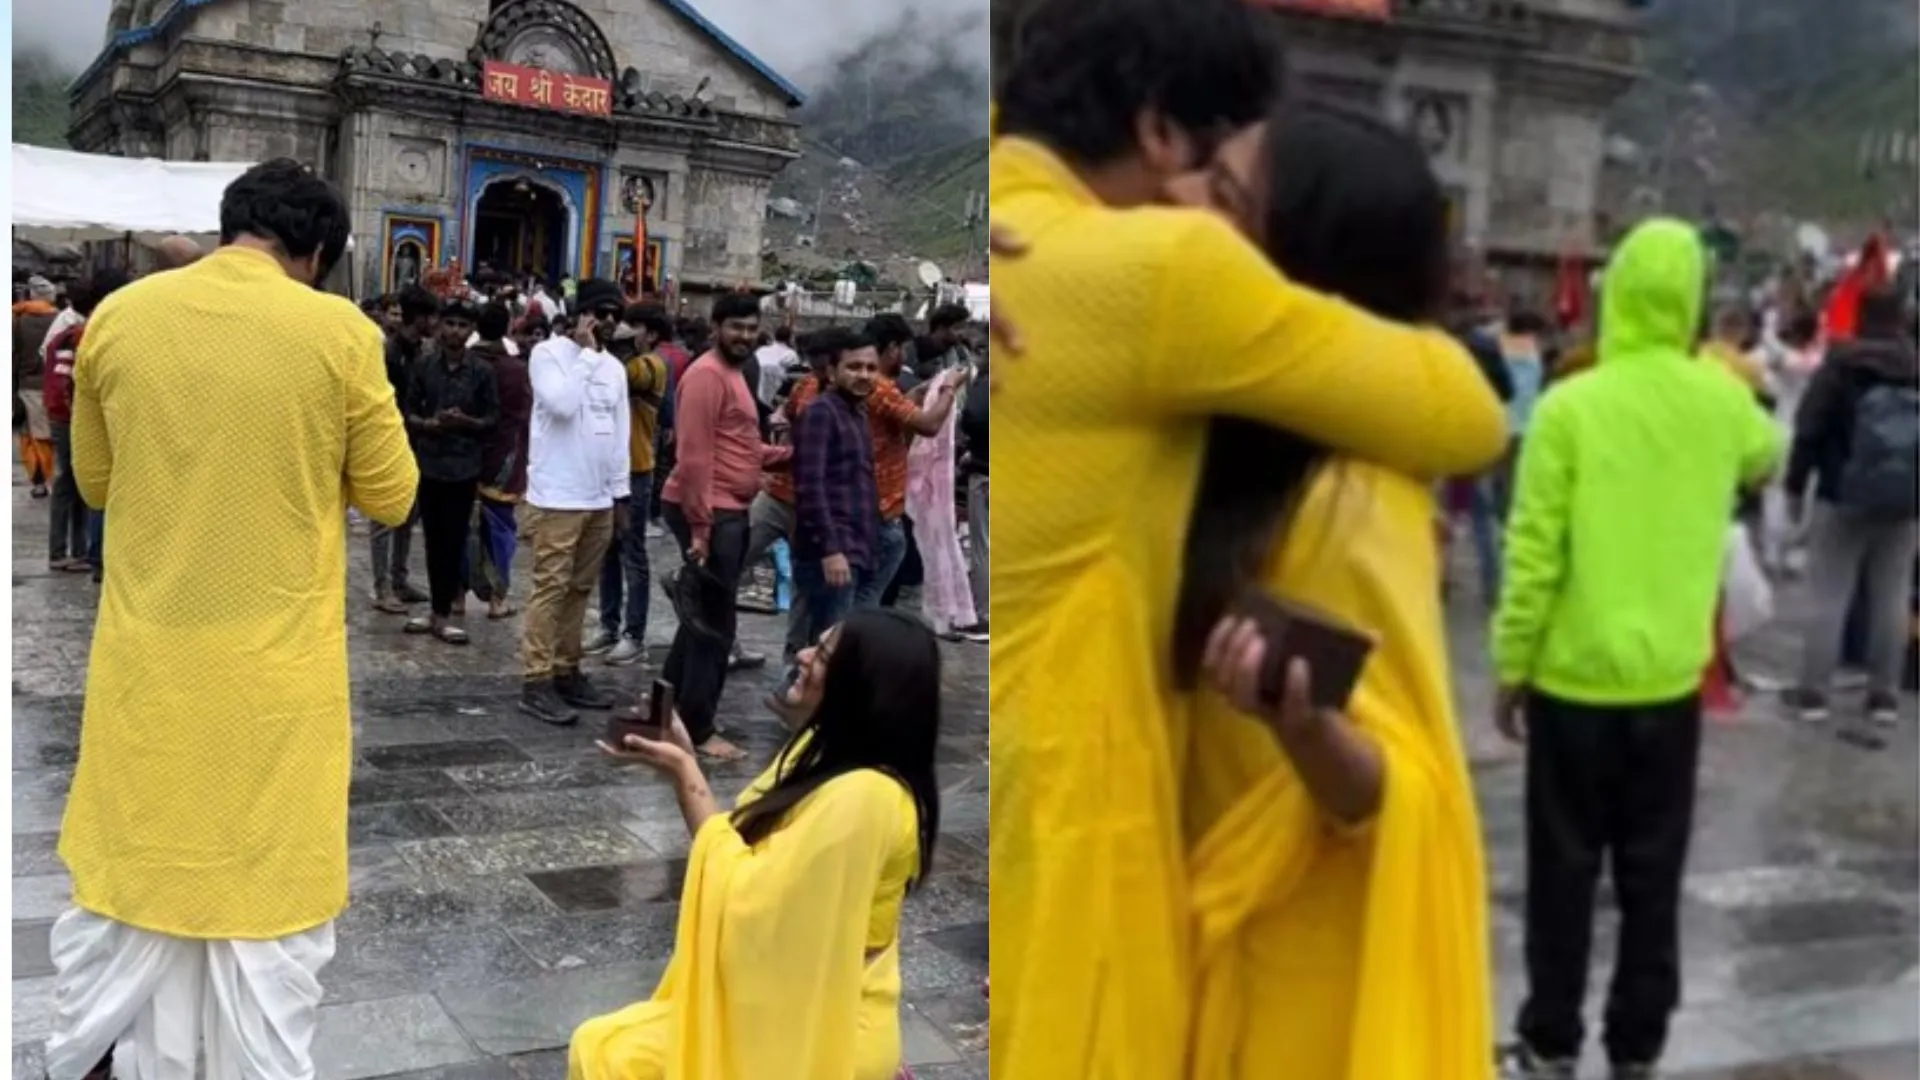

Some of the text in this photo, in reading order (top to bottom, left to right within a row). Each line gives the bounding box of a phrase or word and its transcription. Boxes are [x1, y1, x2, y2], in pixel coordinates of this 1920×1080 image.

[488, 69, 608, 114] जय श्री केदार
